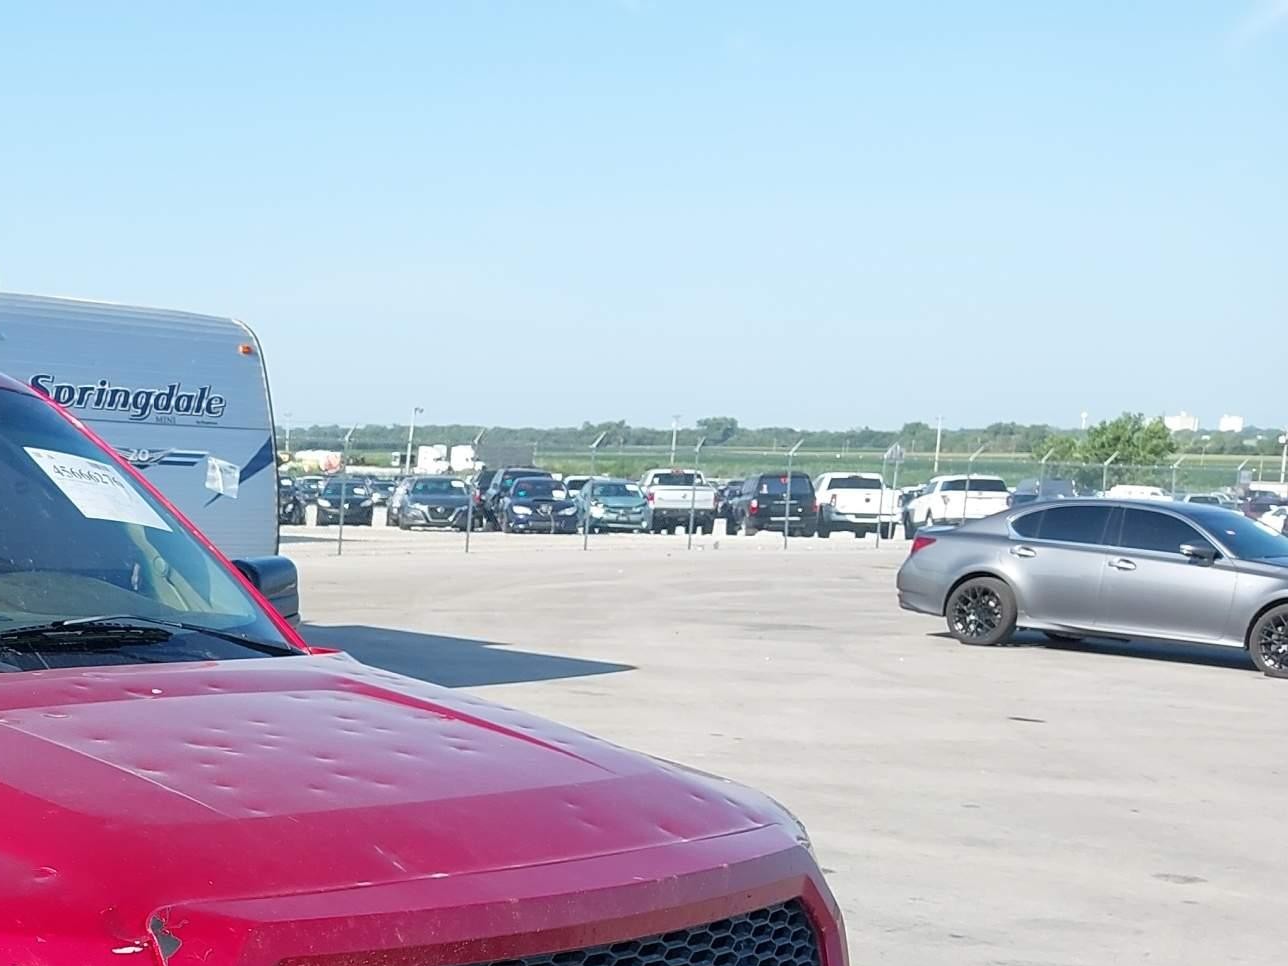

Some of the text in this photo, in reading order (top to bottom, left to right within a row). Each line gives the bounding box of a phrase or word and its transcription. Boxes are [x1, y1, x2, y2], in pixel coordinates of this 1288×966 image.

[29, 373, 226, 421] Springdale
[128, 448, 150, 461] 20
[52, 464, 125, 489] 45666276
